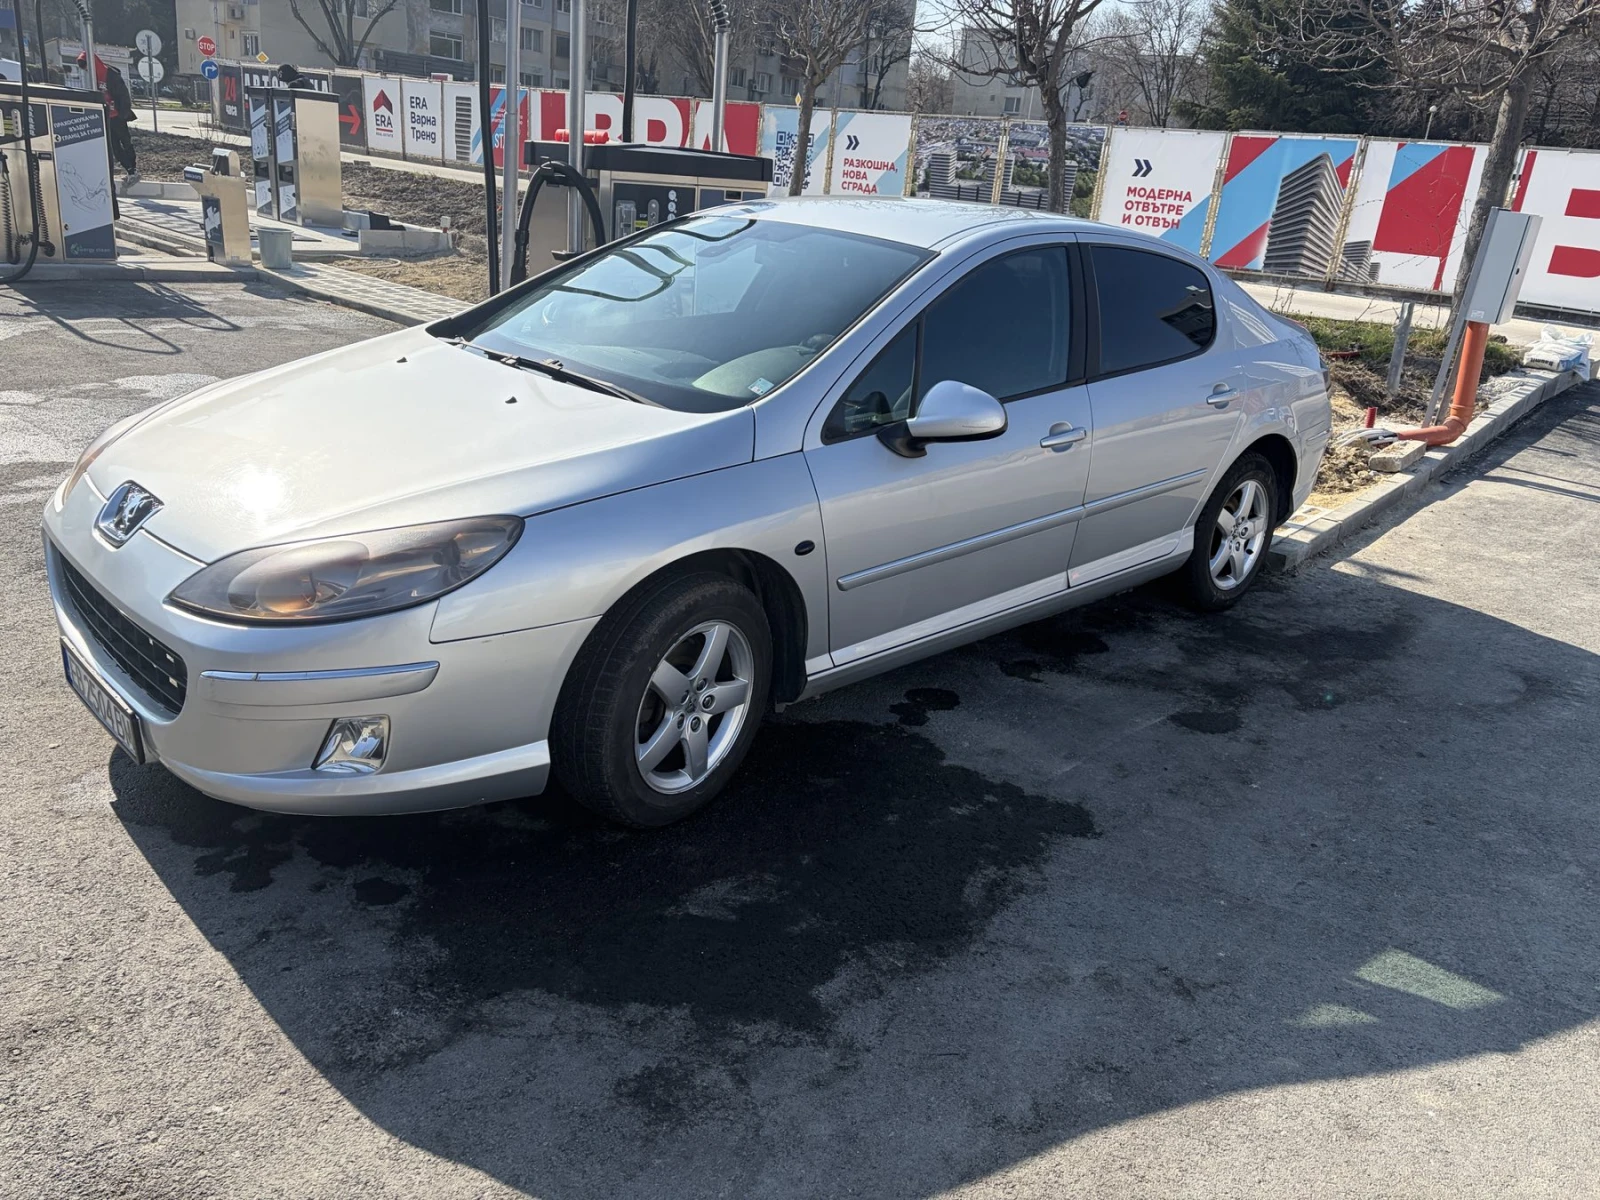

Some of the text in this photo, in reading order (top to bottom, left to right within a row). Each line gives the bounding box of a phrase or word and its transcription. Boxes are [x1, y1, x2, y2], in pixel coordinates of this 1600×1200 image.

[199, 42, 215, 51] STOP
[224, 77, 237, 102] 24
[410, 96, 428, 110] ERA
[374, 113, 393, 128] ERA
[410, 111, 437, 127] Варна
[410, 126, 437, 144] Тренд
[843, 158, 899, 173] РАЗКОШНА,
[842, 170, 868, 180] НОВА
[841, 181, 878, 194] СГРАДА
[1127, 186, 1192, 202] МОДЕРНА
[1124, 200, 1184, 216] ОТВЪТРЕ
[1121, 213, 1181, 230] И ОТВЪН
